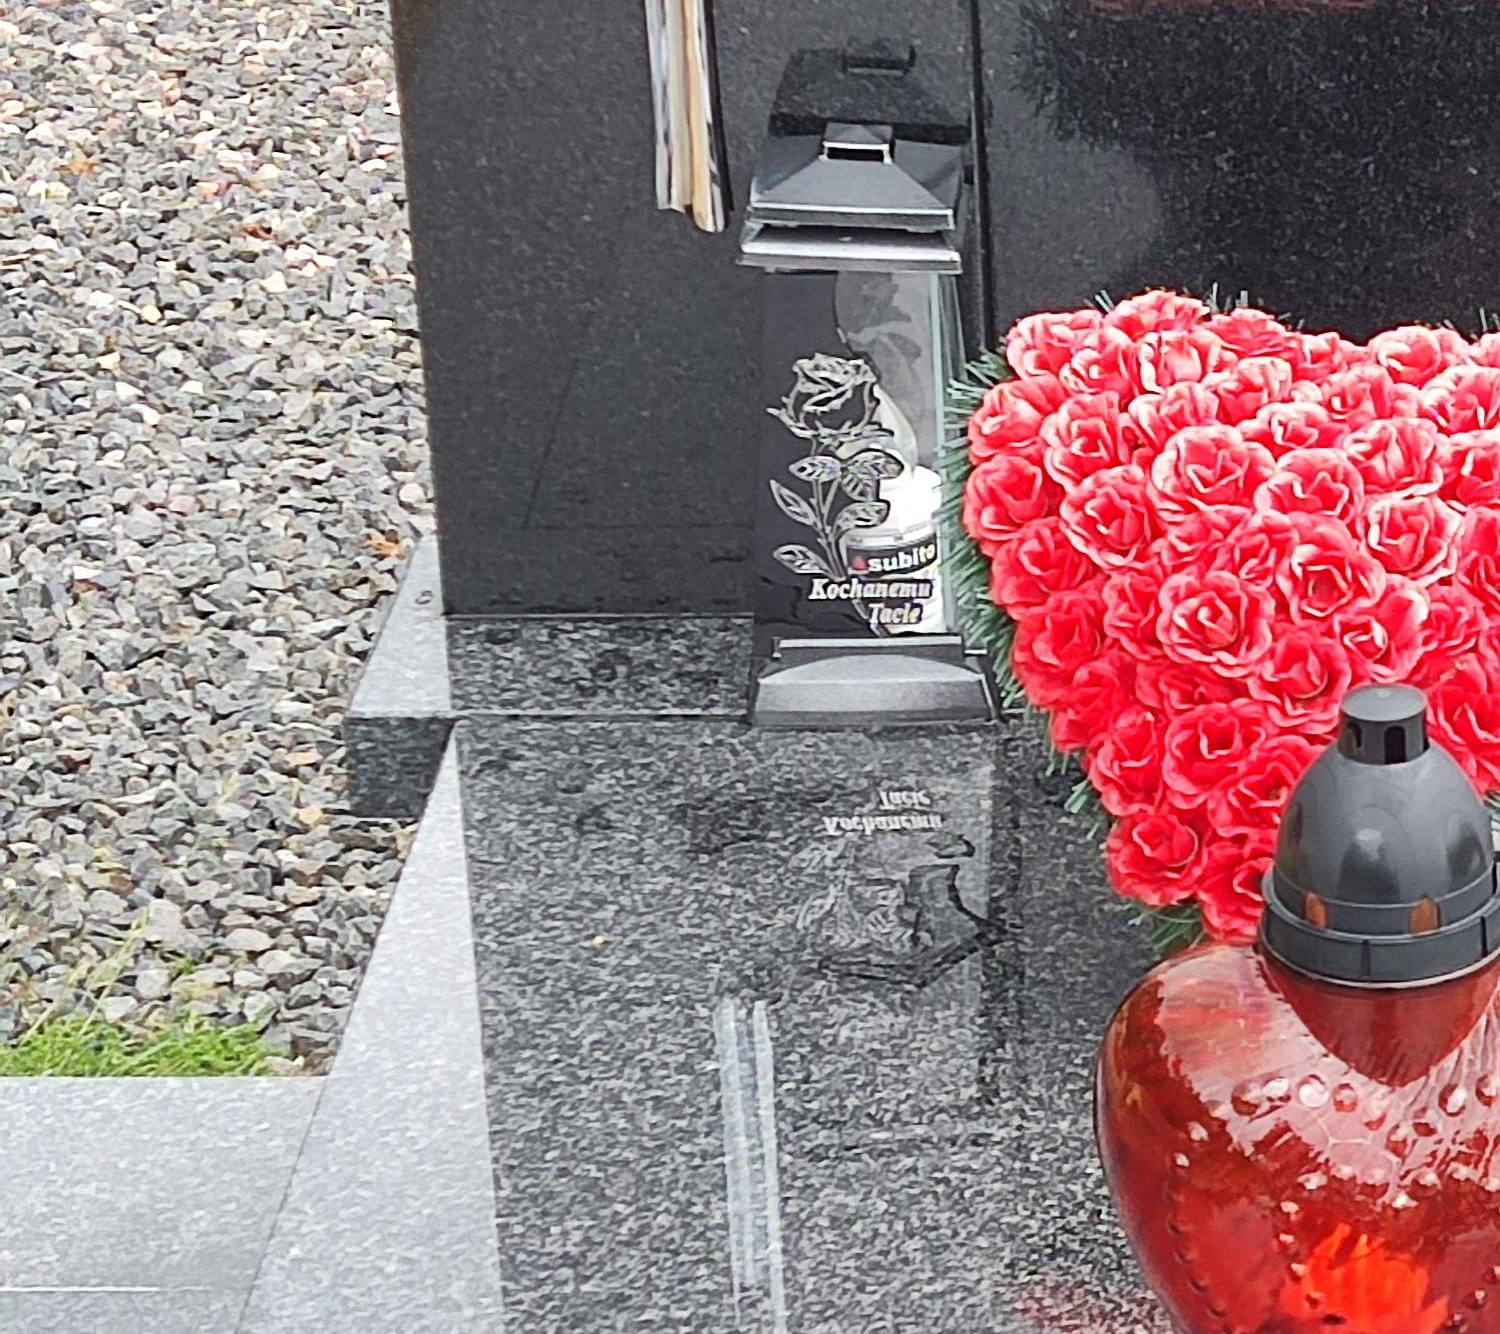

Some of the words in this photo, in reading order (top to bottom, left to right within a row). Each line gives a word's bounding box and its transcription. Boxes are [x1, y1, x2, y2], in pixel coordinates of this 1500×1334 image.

[868, 544, 936, 572] subito
[808, 578, 933, 600] Kochanemu
[868, 603, 921, 624] Tacie
